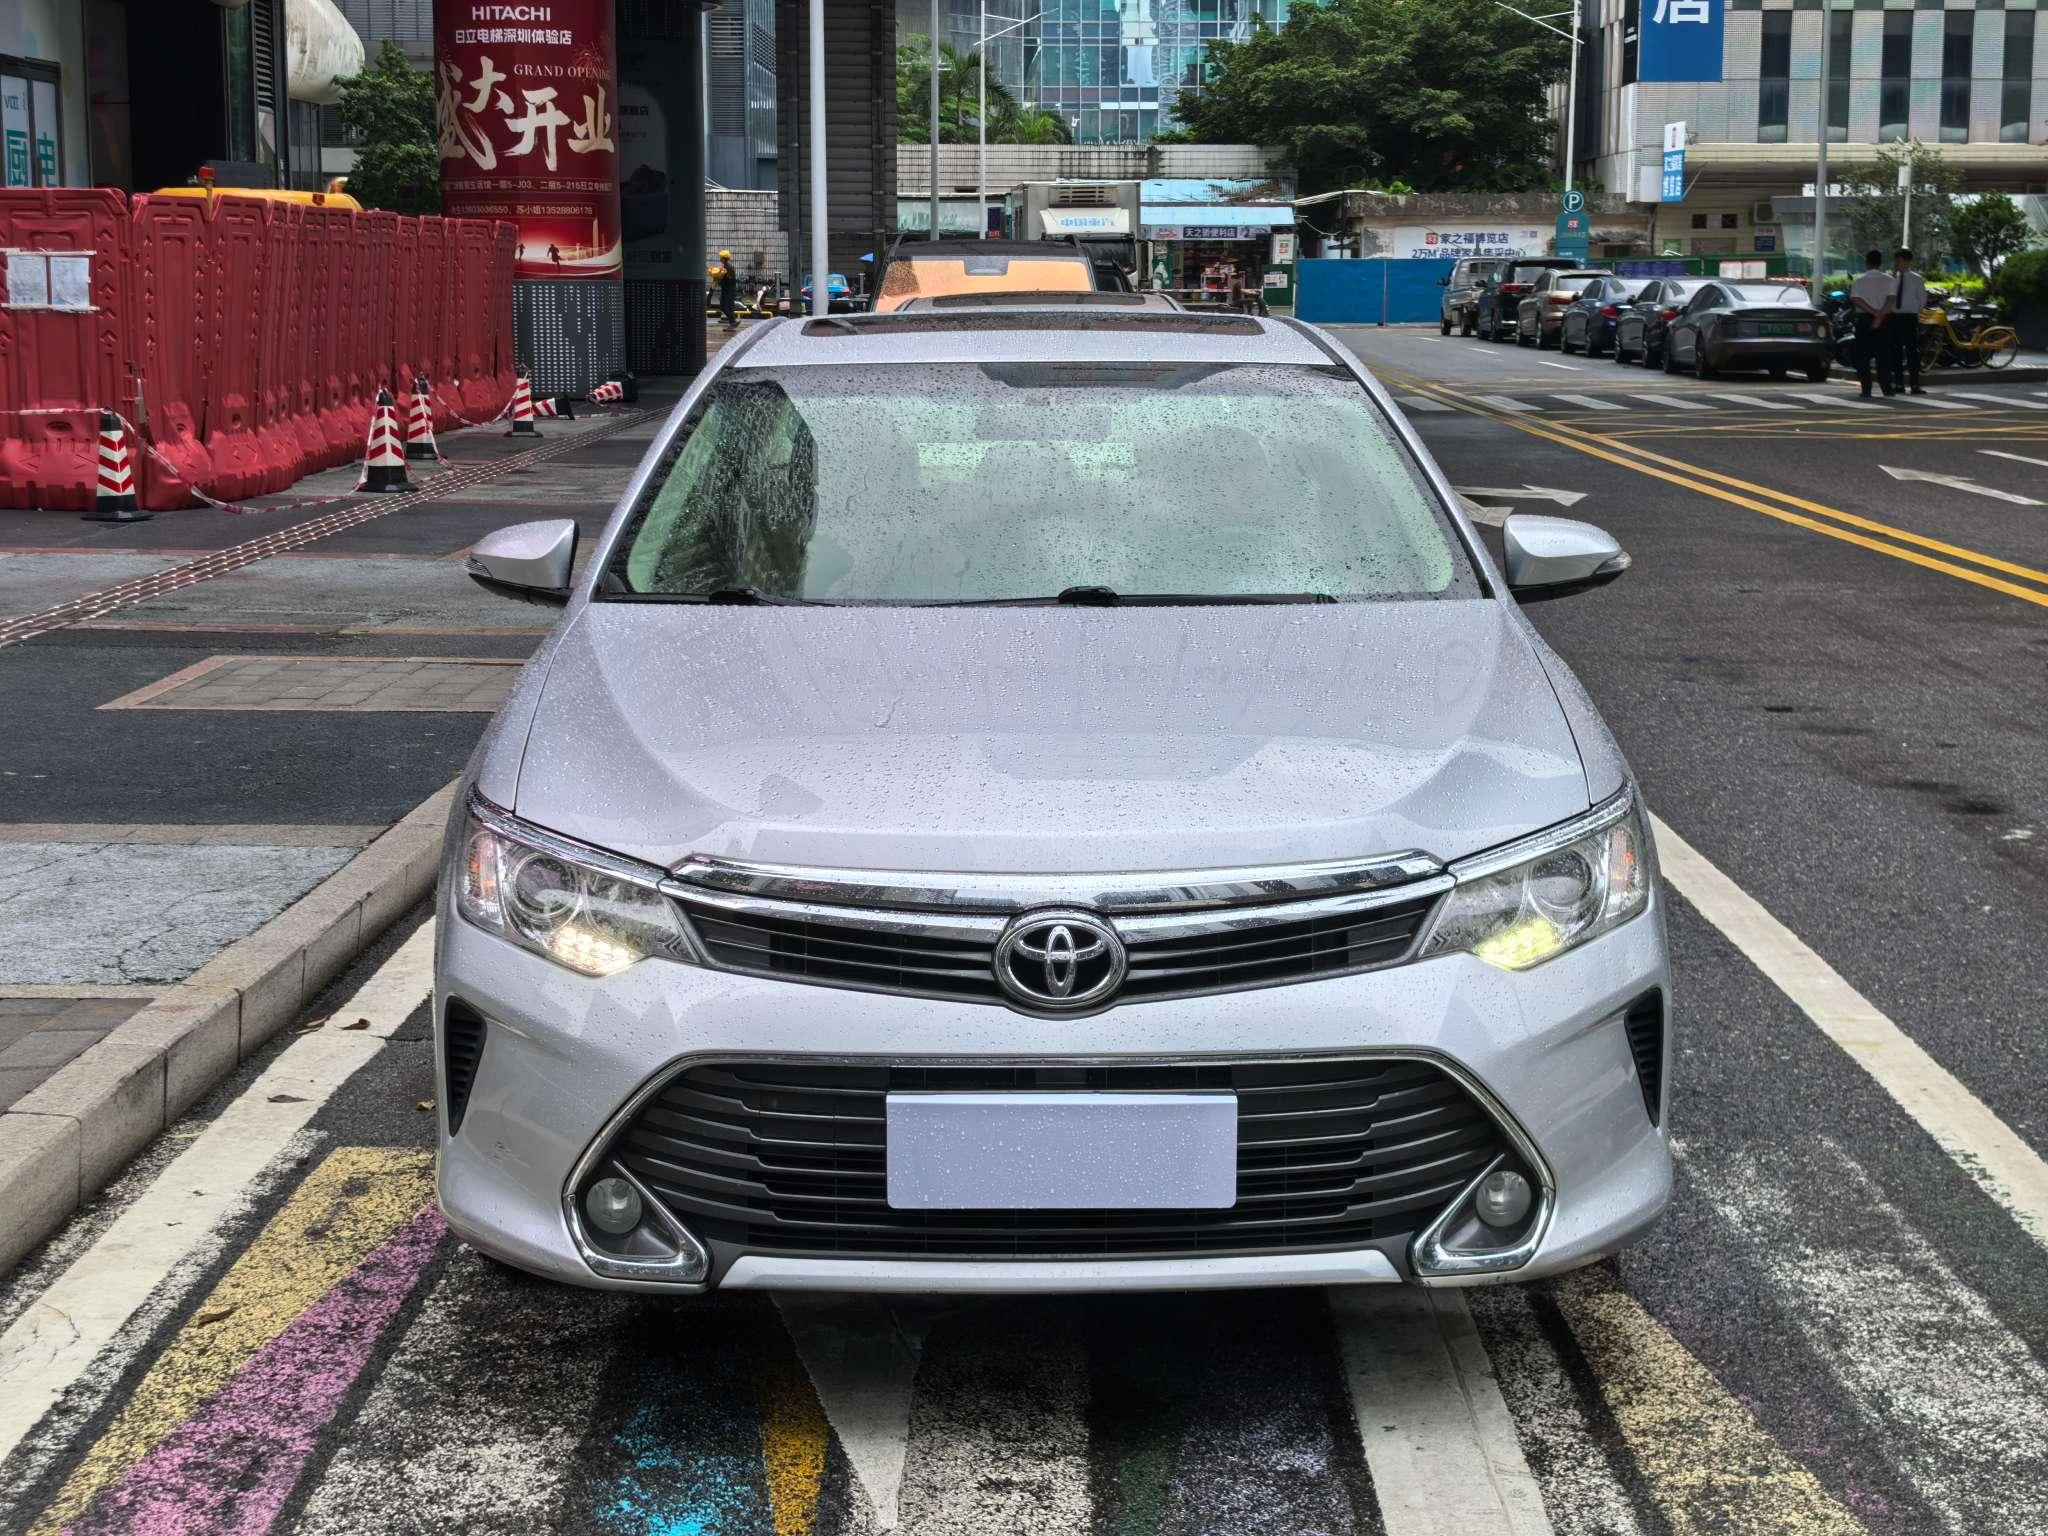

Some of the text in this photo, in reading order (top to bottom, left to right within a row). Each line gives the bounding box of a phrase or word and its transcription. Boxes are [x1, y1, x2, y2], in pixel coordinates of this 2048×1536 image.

[472, 6, 551, 22] HITACHI
[455, 28, 573, 46] 日立电梯深圳体验店
[514, 64, 564, 78] GRAND
[1568, 193, 1580, 210] P
